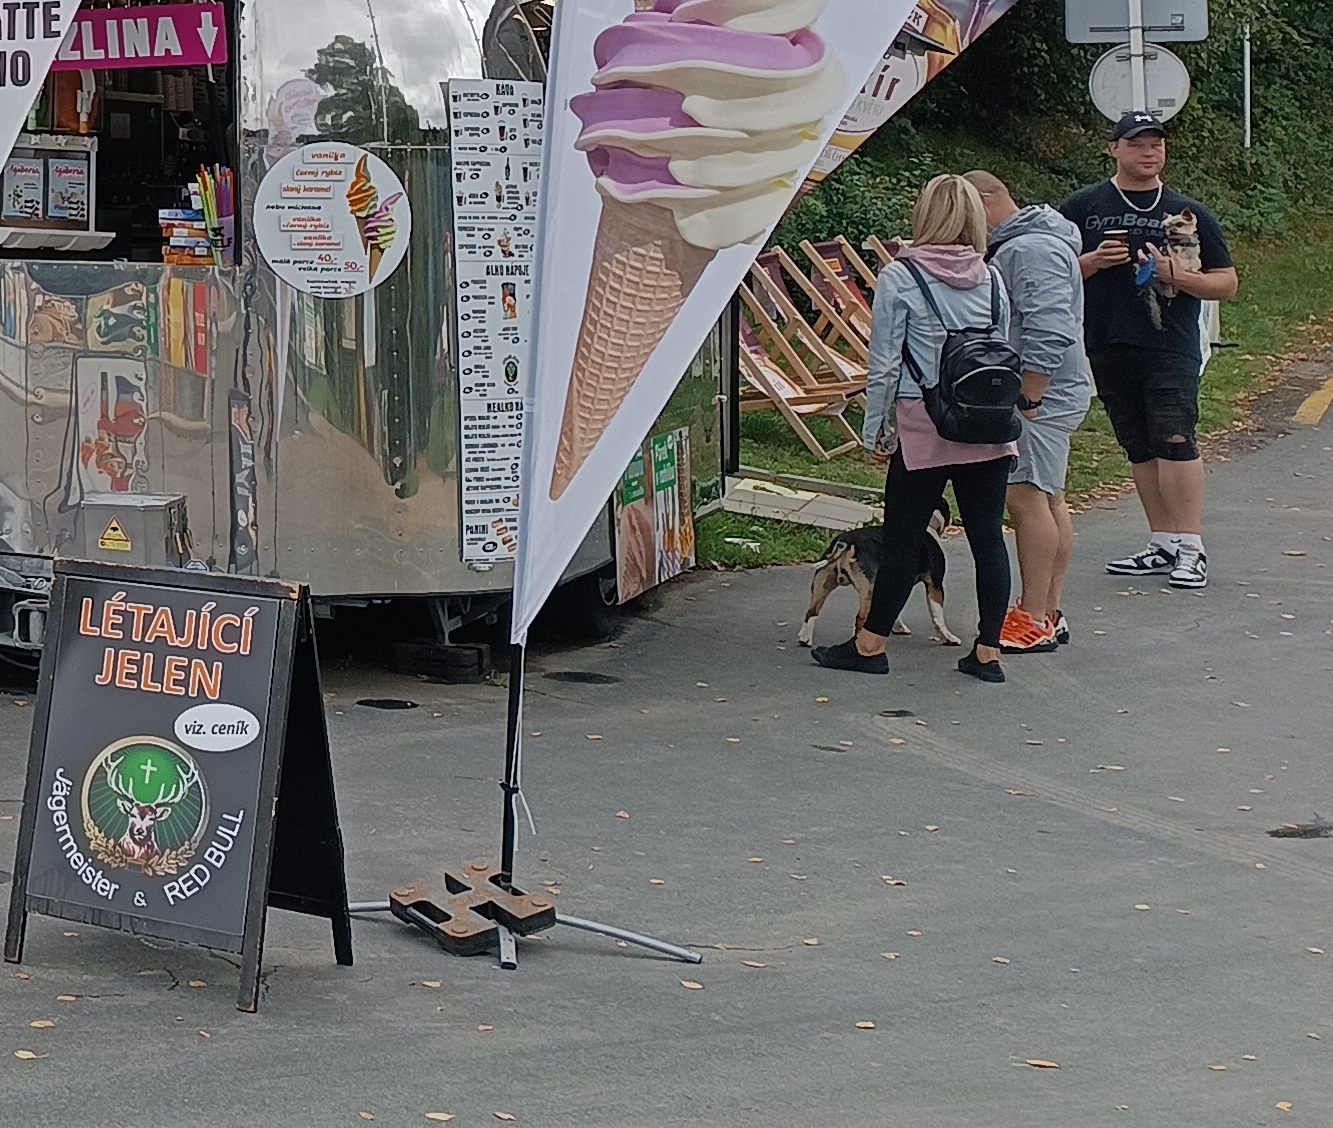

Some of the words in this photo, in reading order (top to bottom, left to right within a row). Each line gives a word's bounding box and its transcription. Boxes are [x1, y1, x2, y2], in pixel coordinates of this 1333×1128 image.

[79, 592, 259, 655] LÉTAJÍCÍ
[95, 648, 223, 700] JELEN
[184, 720, 206, 736] viz.
[210, 720, 249, 736] ceník
[46, 768, 120, 901] Jägermeister
[133, 891, 147, 907] &
[163, 863, 211, 906] RED
[203, 808, 245, 869] BULL
